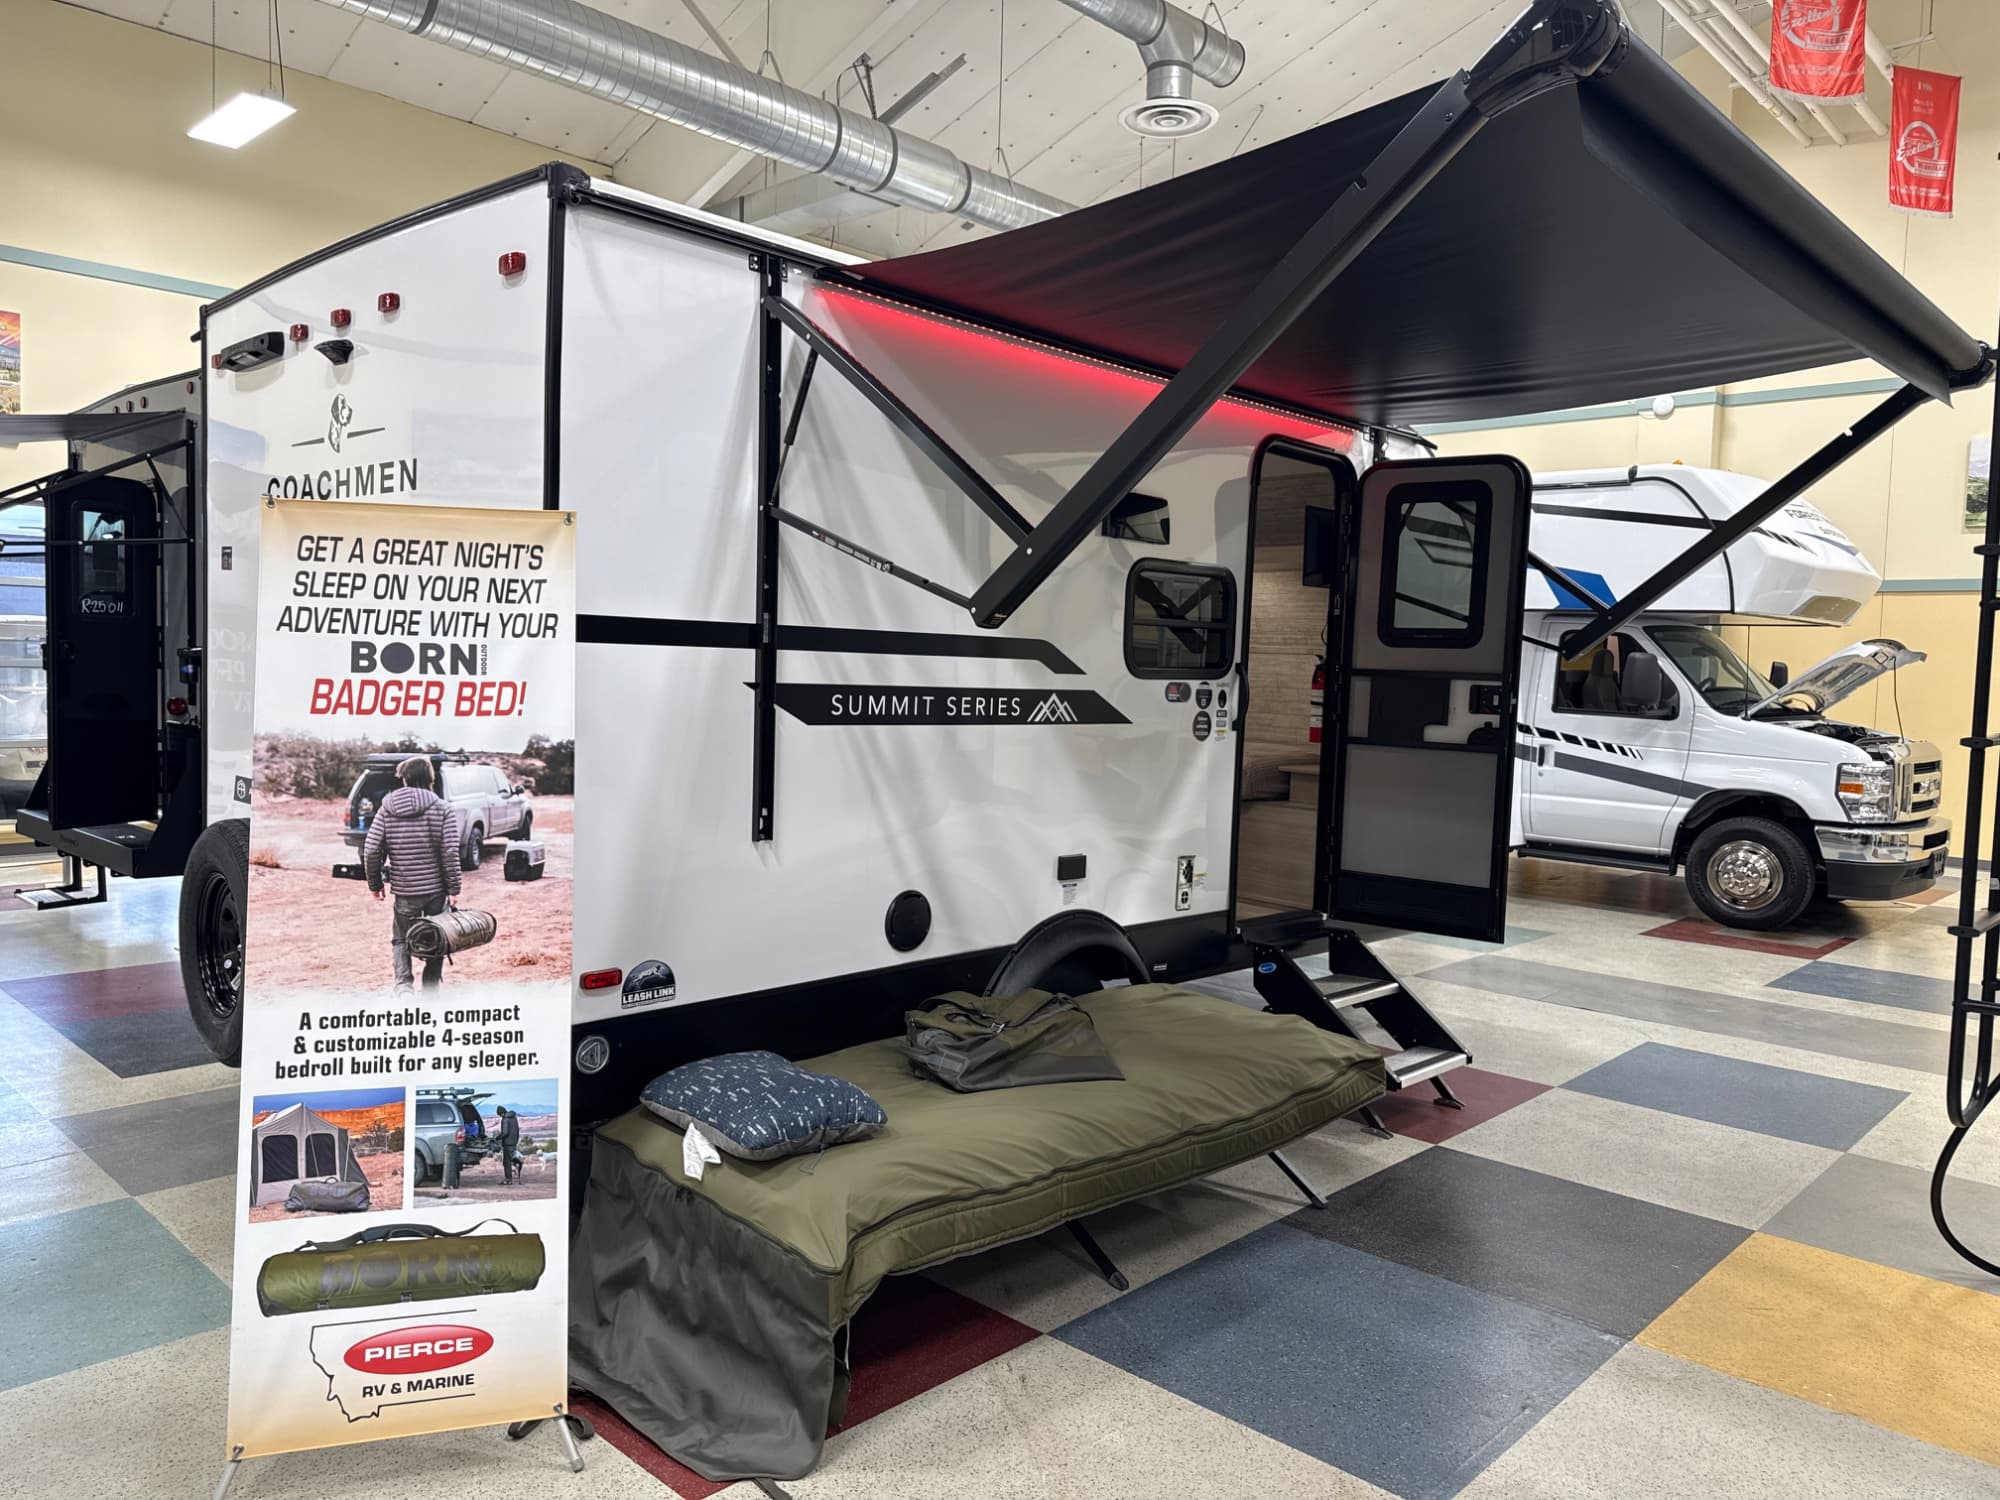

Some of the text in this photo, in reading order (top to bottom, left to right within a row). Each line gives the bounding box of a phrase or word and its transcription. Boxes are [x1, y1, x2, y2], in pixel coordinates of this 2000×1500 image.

[267, 458, 417, 500] COACHMEN
[296, 535, 544, 570] GET A GREAT NIGHT'S
[292, 571, 547, 604] SLEEP ON YOUR NEXT
[275, 605, 559, 639] ADVENTURE WITH YOUR
[351, 641, 477, 676] BORN
[480, 644, 488, 676] OUTDOOR
[310, 678, 528, 717] BADGER BED!
[831, 694, 1021, 717] SUMMIT SERIES
[622, 986, 675, 1004] LEASH LINK
[299, 1004, 521, 1030] A comfortable, compact
[293, 1028, 524, 1055] & customizable 4-season
[275, 1049, 539, 1080] bedroll built for any sleeper.
[364, 1337, 473, 1362] PIERCE
[362, 1373, 475, 1398] RV & MARINE
